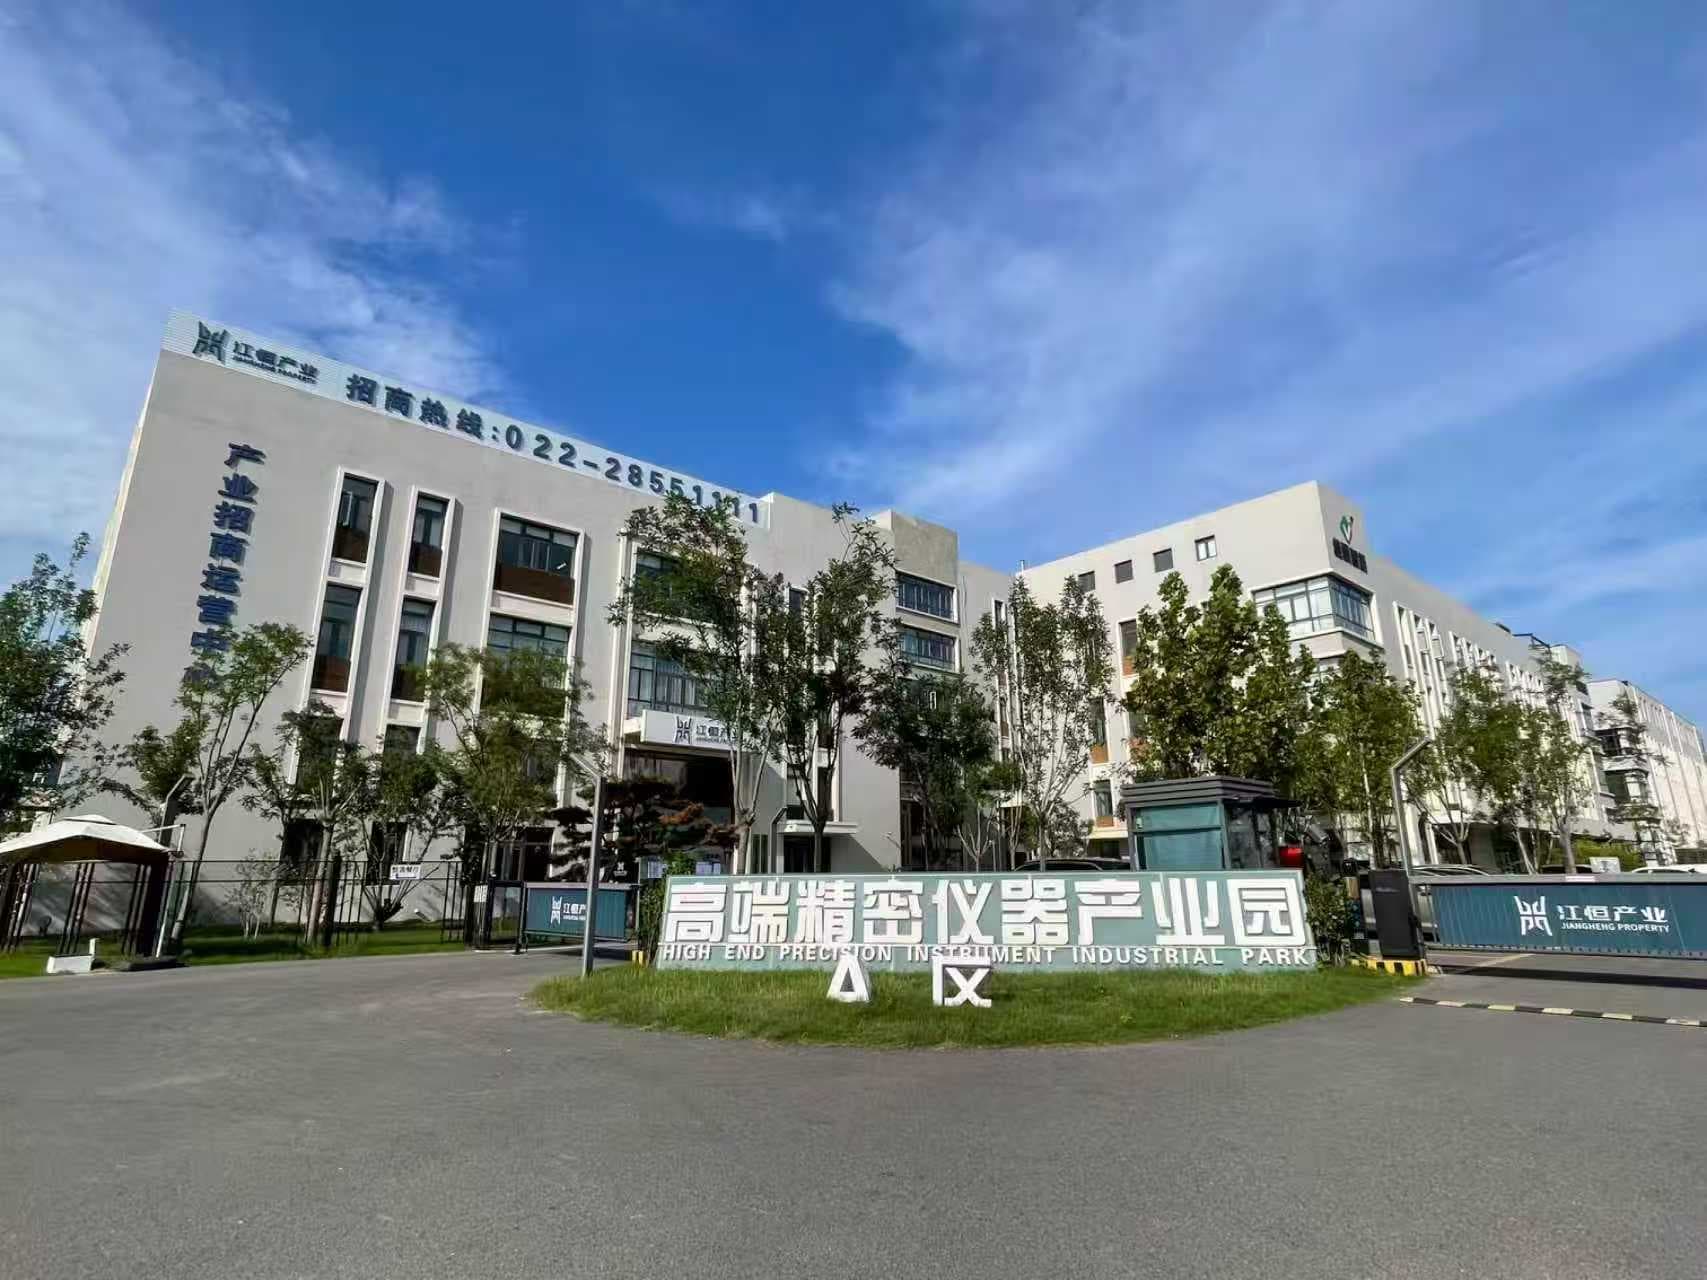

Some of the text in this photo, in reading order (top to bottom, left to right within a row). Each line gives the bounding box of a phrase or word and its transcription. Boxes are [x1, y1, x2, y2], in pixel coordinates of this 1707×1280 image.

[664, 878, 1306, 946] 高端精密仪器产业园
[1557, 904, 1668, 923] 江恒产业
[1561, 922, 1670, 933] JIANGHENG PROPERTY
[663, 944, 1310, 966] HIGH END PRECISION INSTRUMENT INDUSTRIAL PARK
